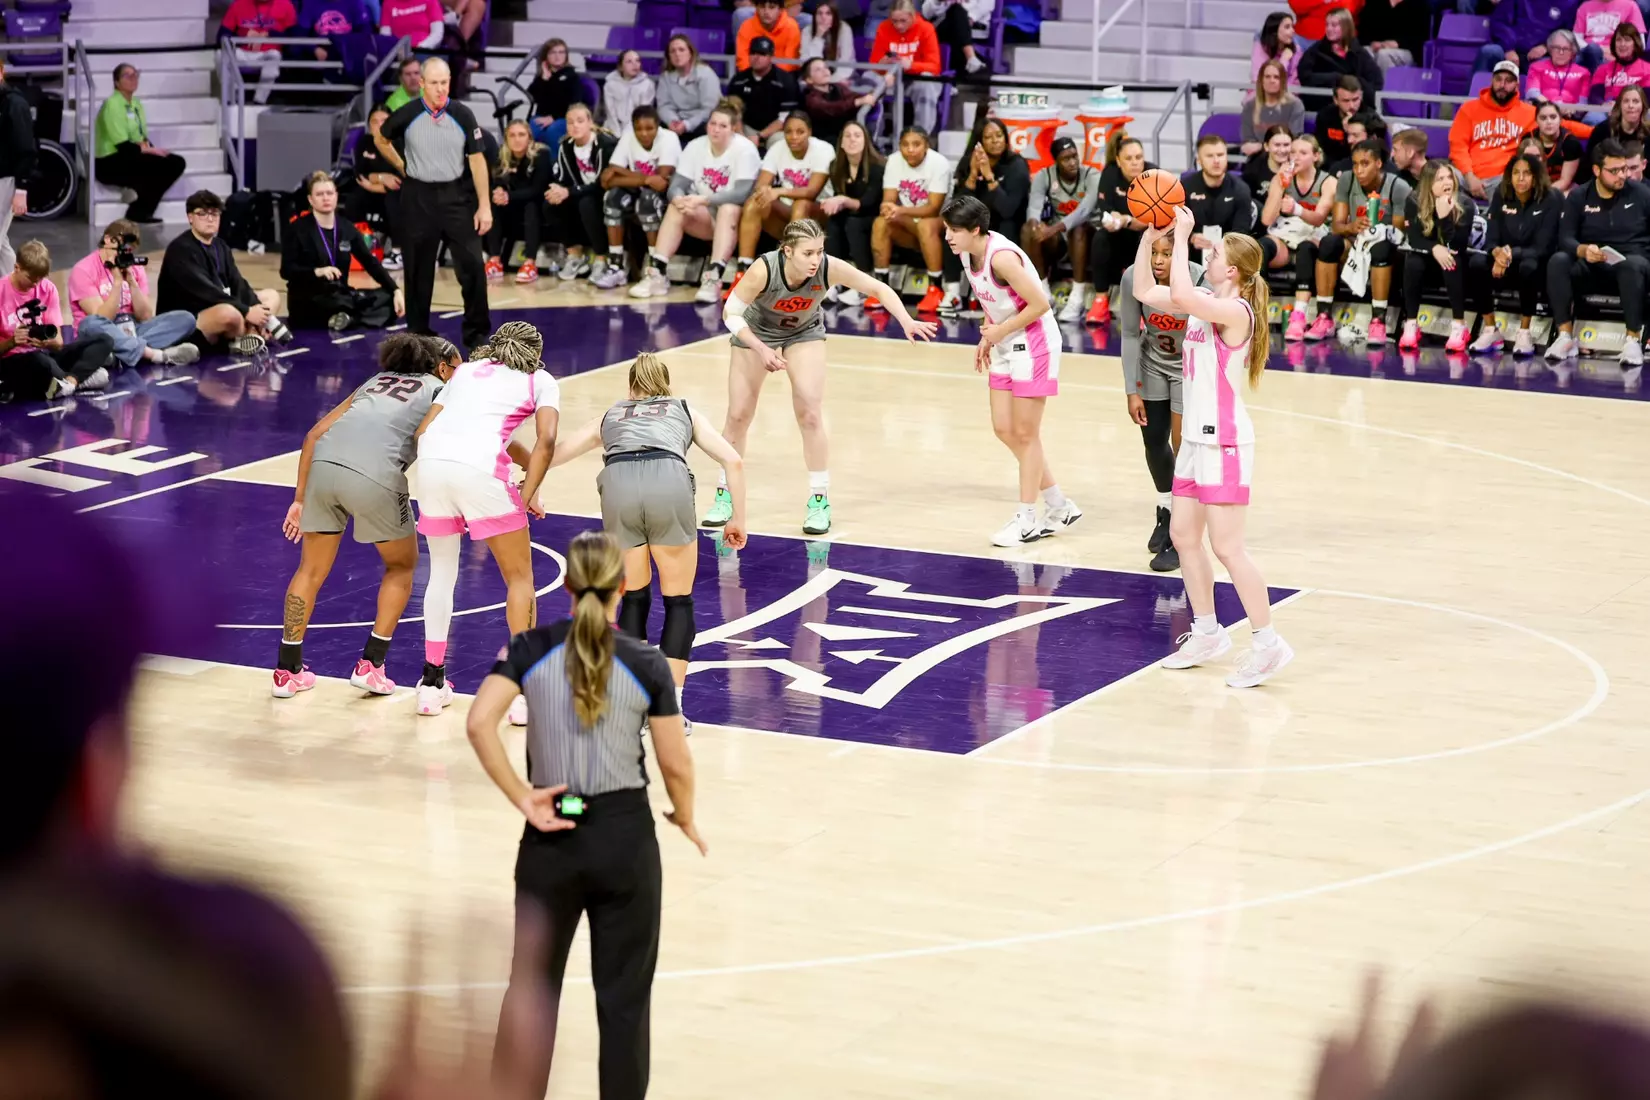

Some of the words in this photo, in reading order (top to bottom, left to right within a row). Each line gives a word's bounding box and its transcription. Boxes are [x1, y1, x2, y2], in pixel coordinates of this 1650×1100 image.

[1010, 129, 1028, 151] G
[1089, 127, 1107, 149] G
[773, 296, 816, 313] OSU
[779, 315, 800, 329] 2
[1147, 312, 1187, 331] OSU
[1157, 334, 1177, 354] 3
[365, 375, 425, 403] 32
[616, 401, 671, 423] 13
